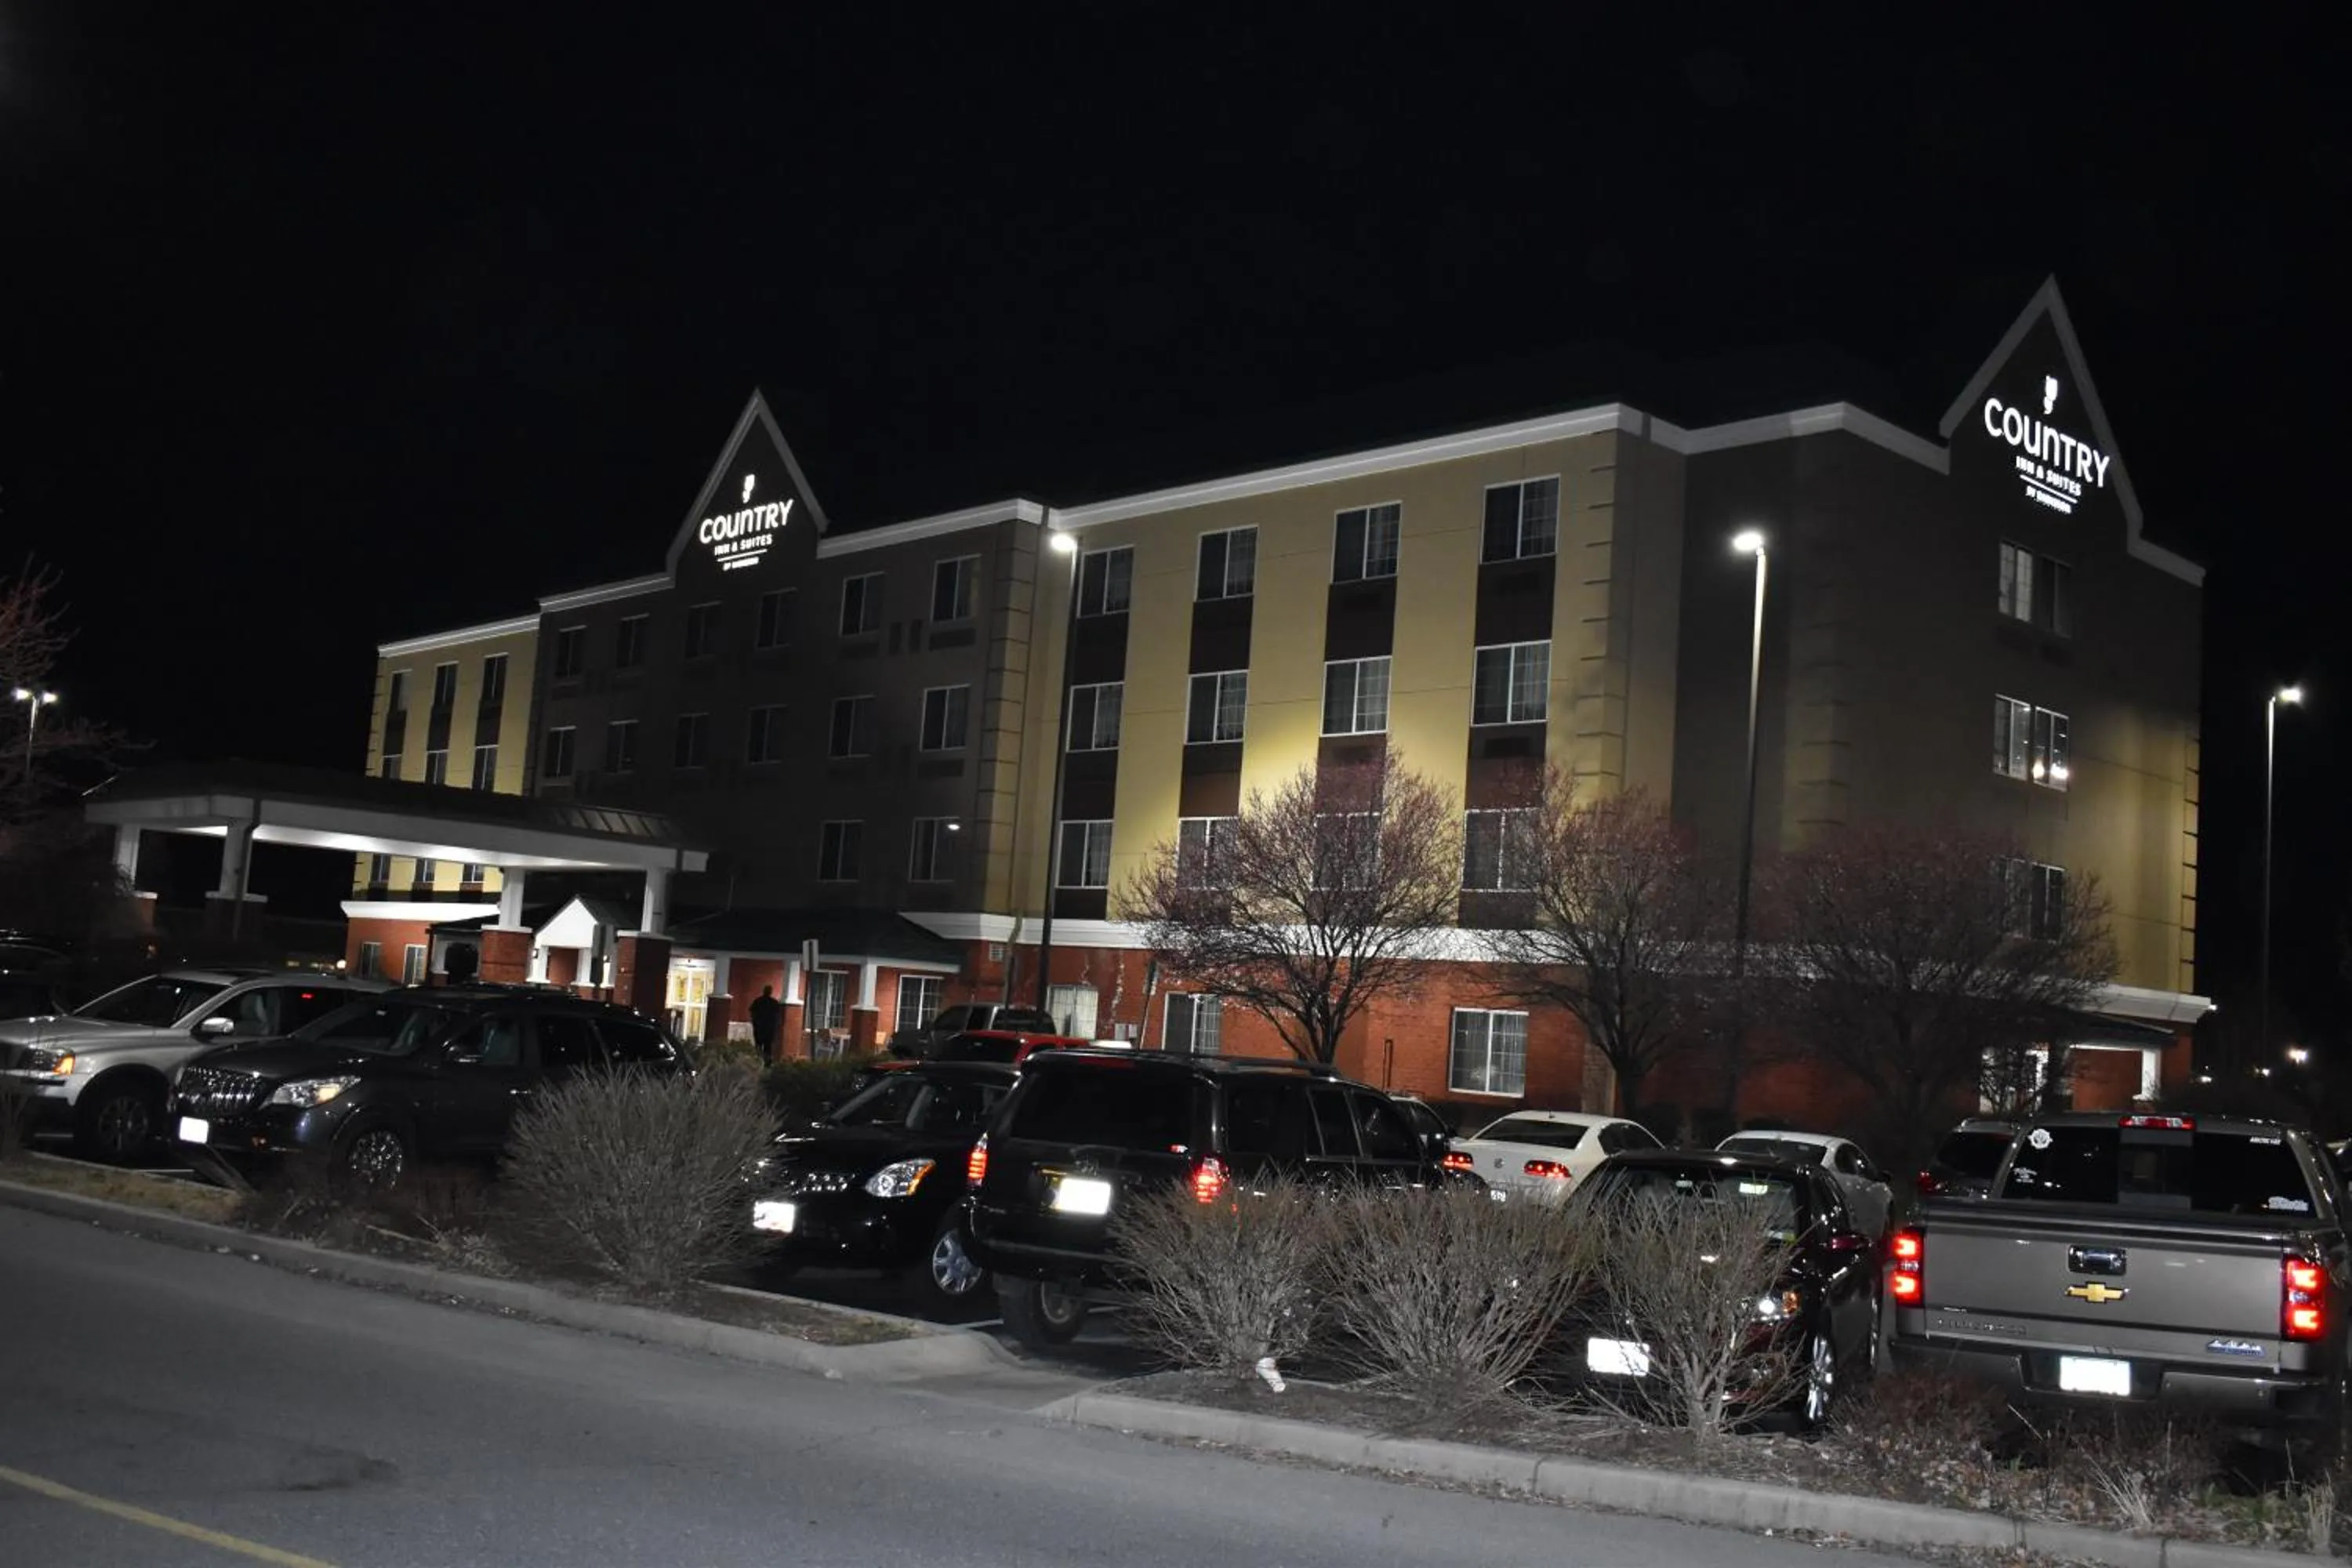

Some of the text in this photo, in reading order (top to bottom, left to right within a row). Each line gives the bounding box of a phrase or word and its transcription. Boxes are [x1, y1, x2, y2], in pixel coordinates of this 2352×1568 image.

[1984, 397, 2110, 488] COUNTRY
[2046, 470, 2082, 496] SUITES
[700, 499, 793, 544] COUNTRY
[740, 535, 772, 550] SUITES
